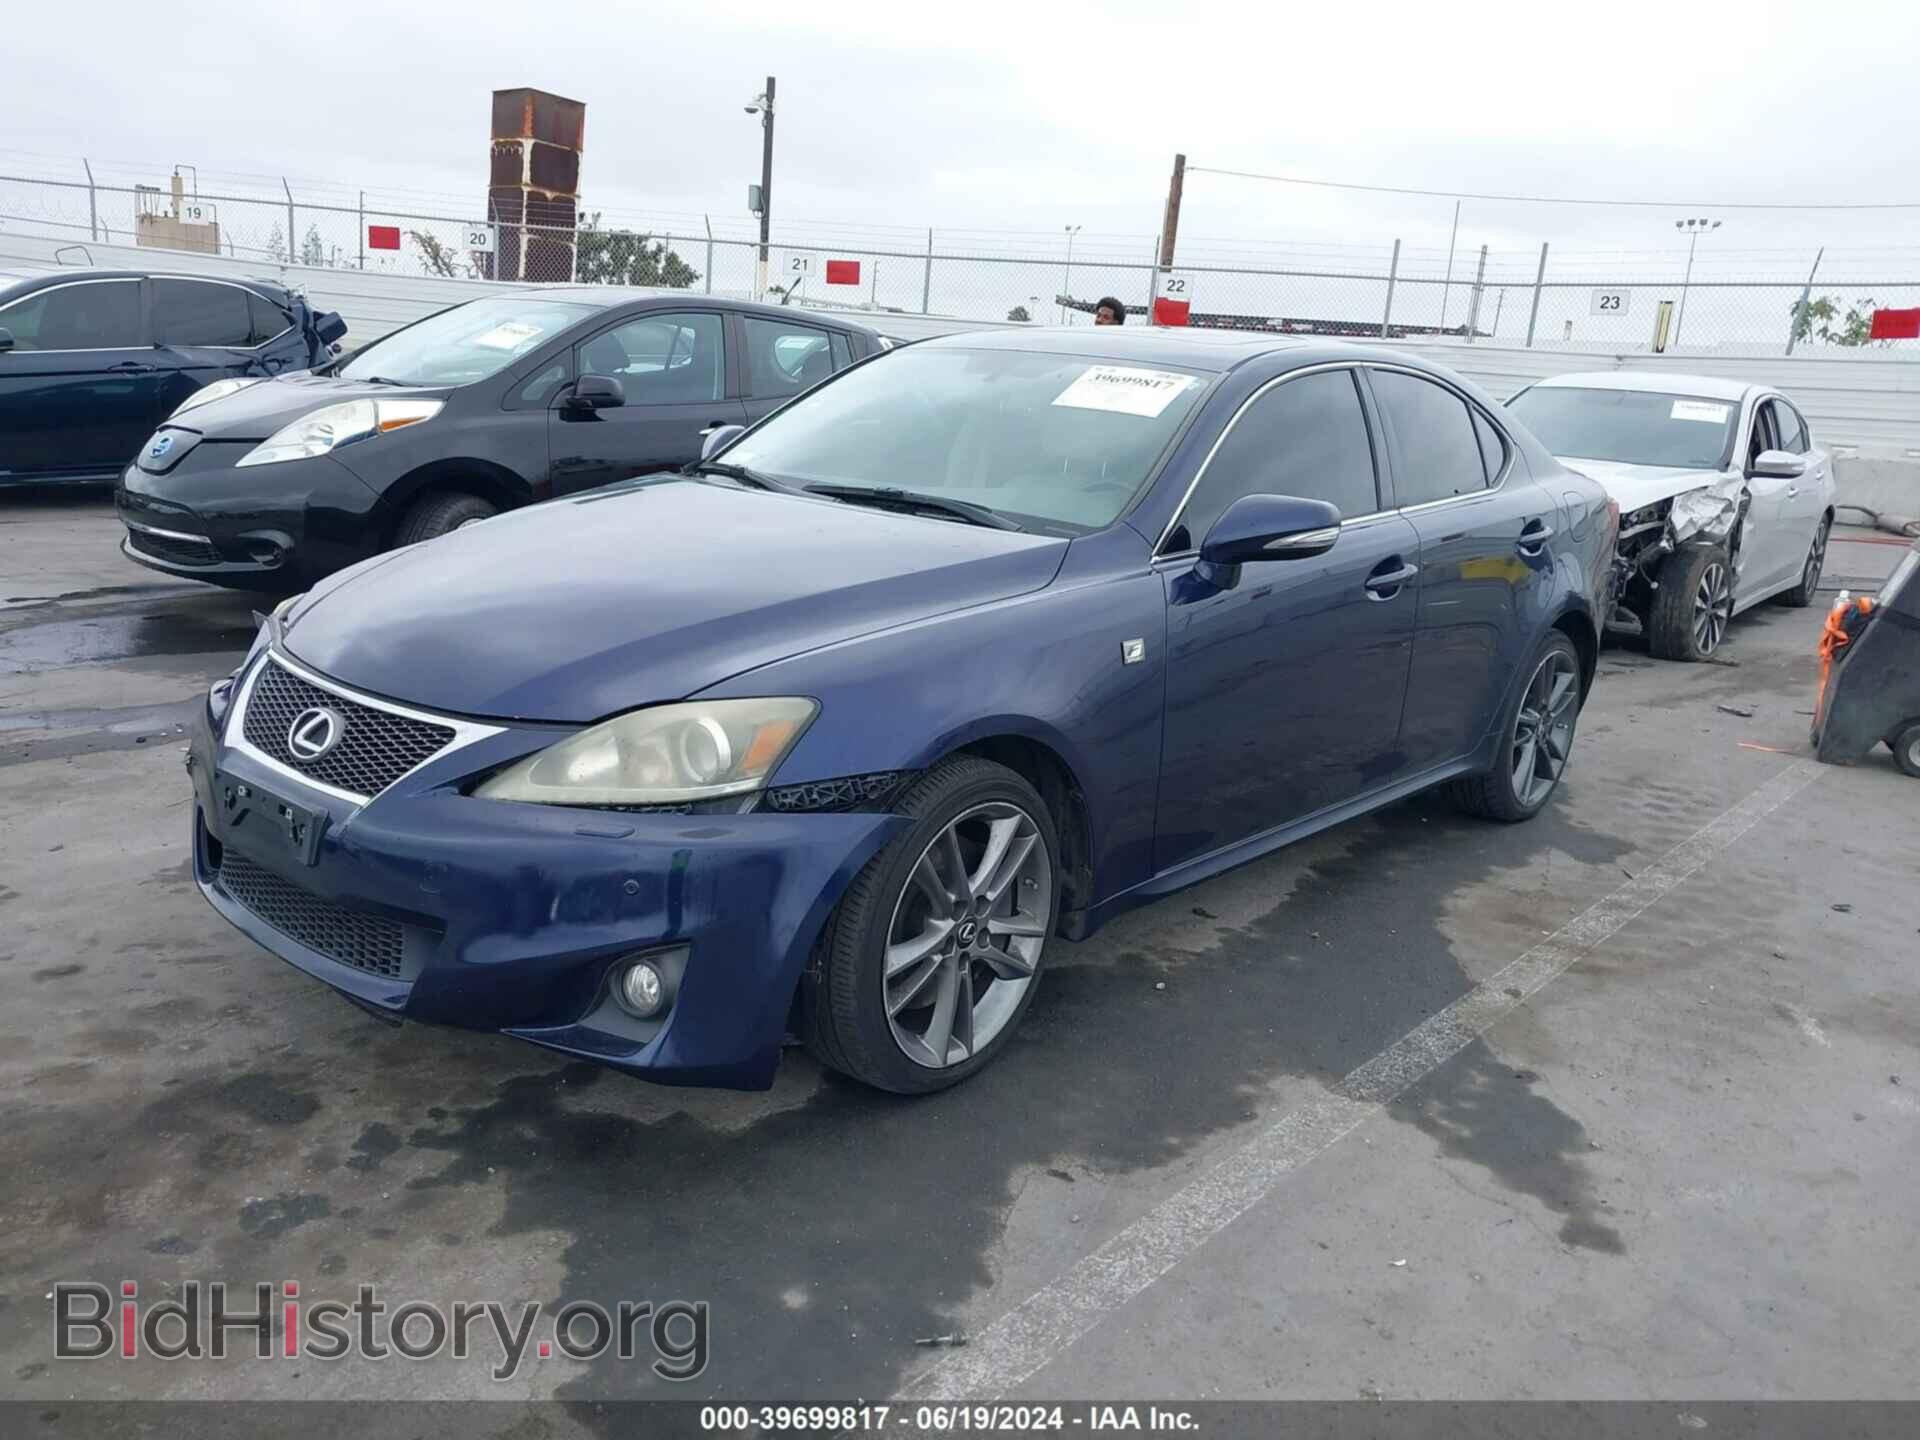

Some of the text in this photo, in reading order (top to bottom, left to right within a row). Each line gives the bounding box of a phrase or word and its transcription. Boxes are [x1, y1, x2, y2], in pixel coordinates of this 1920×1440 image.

[186, 207, 202, 219] 19
[470, 232, 487, 245] 20
[792, 257, 808, 271] 21
[1167, 279, 1185, 293] 22
[1600, 295, 1620, 310] 23
